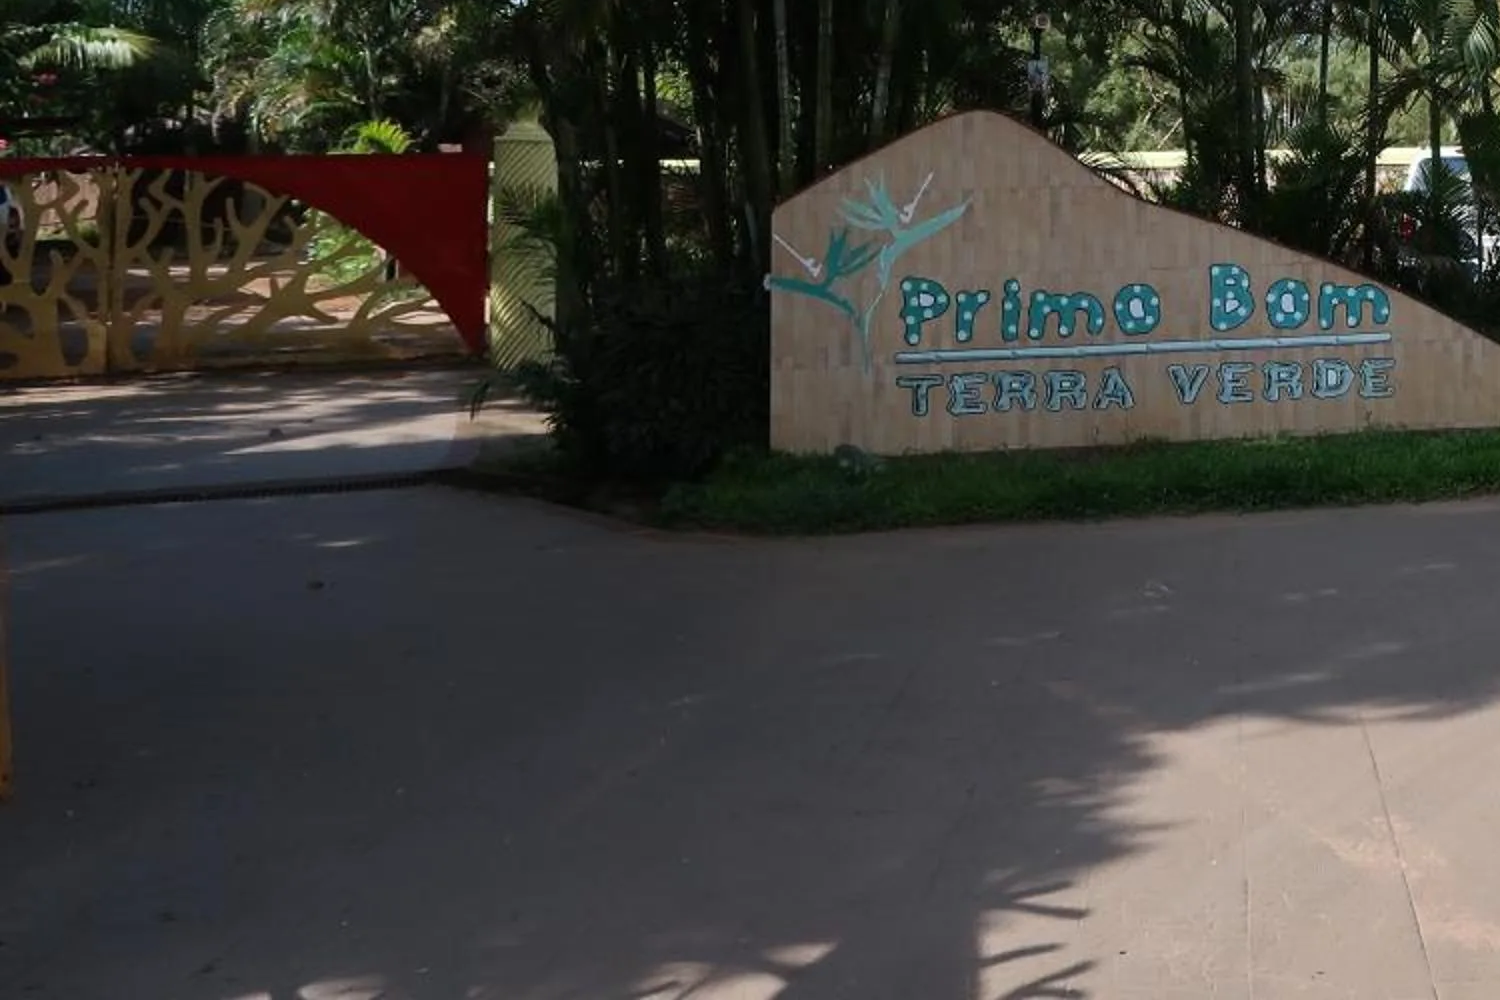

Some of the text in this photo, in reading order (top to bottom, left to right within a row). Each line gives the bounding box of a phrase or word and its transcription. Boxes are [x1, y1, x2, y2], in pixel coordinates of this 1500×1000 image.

[900, 263, 1390, 345] Primo Bom
[896, 357, 1396, 417] TERRA VERDE
